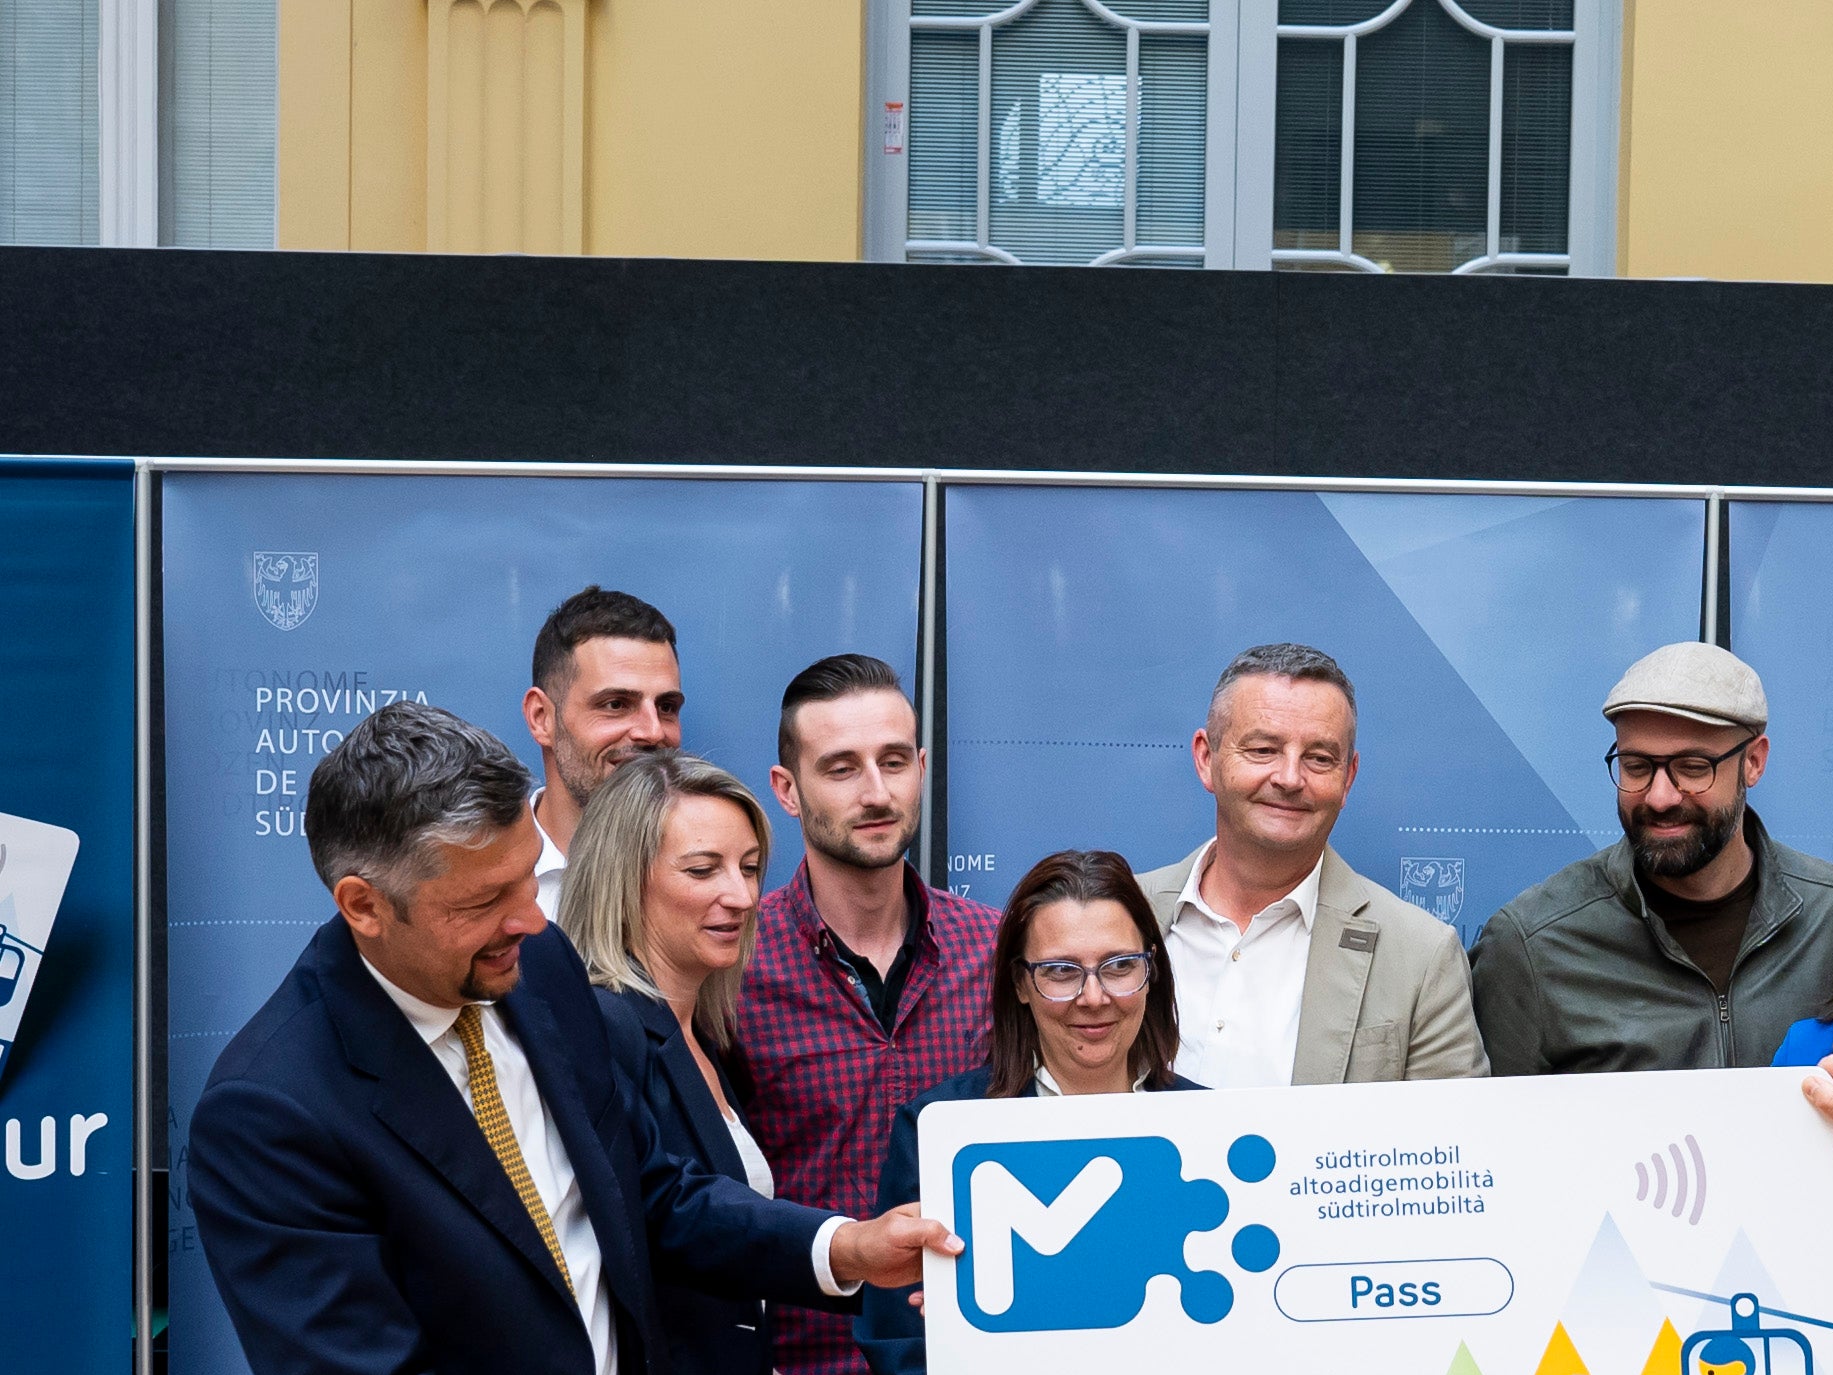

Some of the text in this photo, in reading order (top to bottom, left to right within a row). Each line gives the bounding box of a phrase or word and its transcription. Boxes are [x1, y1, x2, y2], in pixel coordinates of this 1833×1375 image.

[255, 769, 298, 796] DE
[1314, 1145, 1460, 1170] südtirolmobil
[1289, 1169, 1494, 1197] altoadigemobilità
[1317, 1195, 1486, 1220] südtirolmubiltà
[1350, 1275, 1442, 1309] Pass
